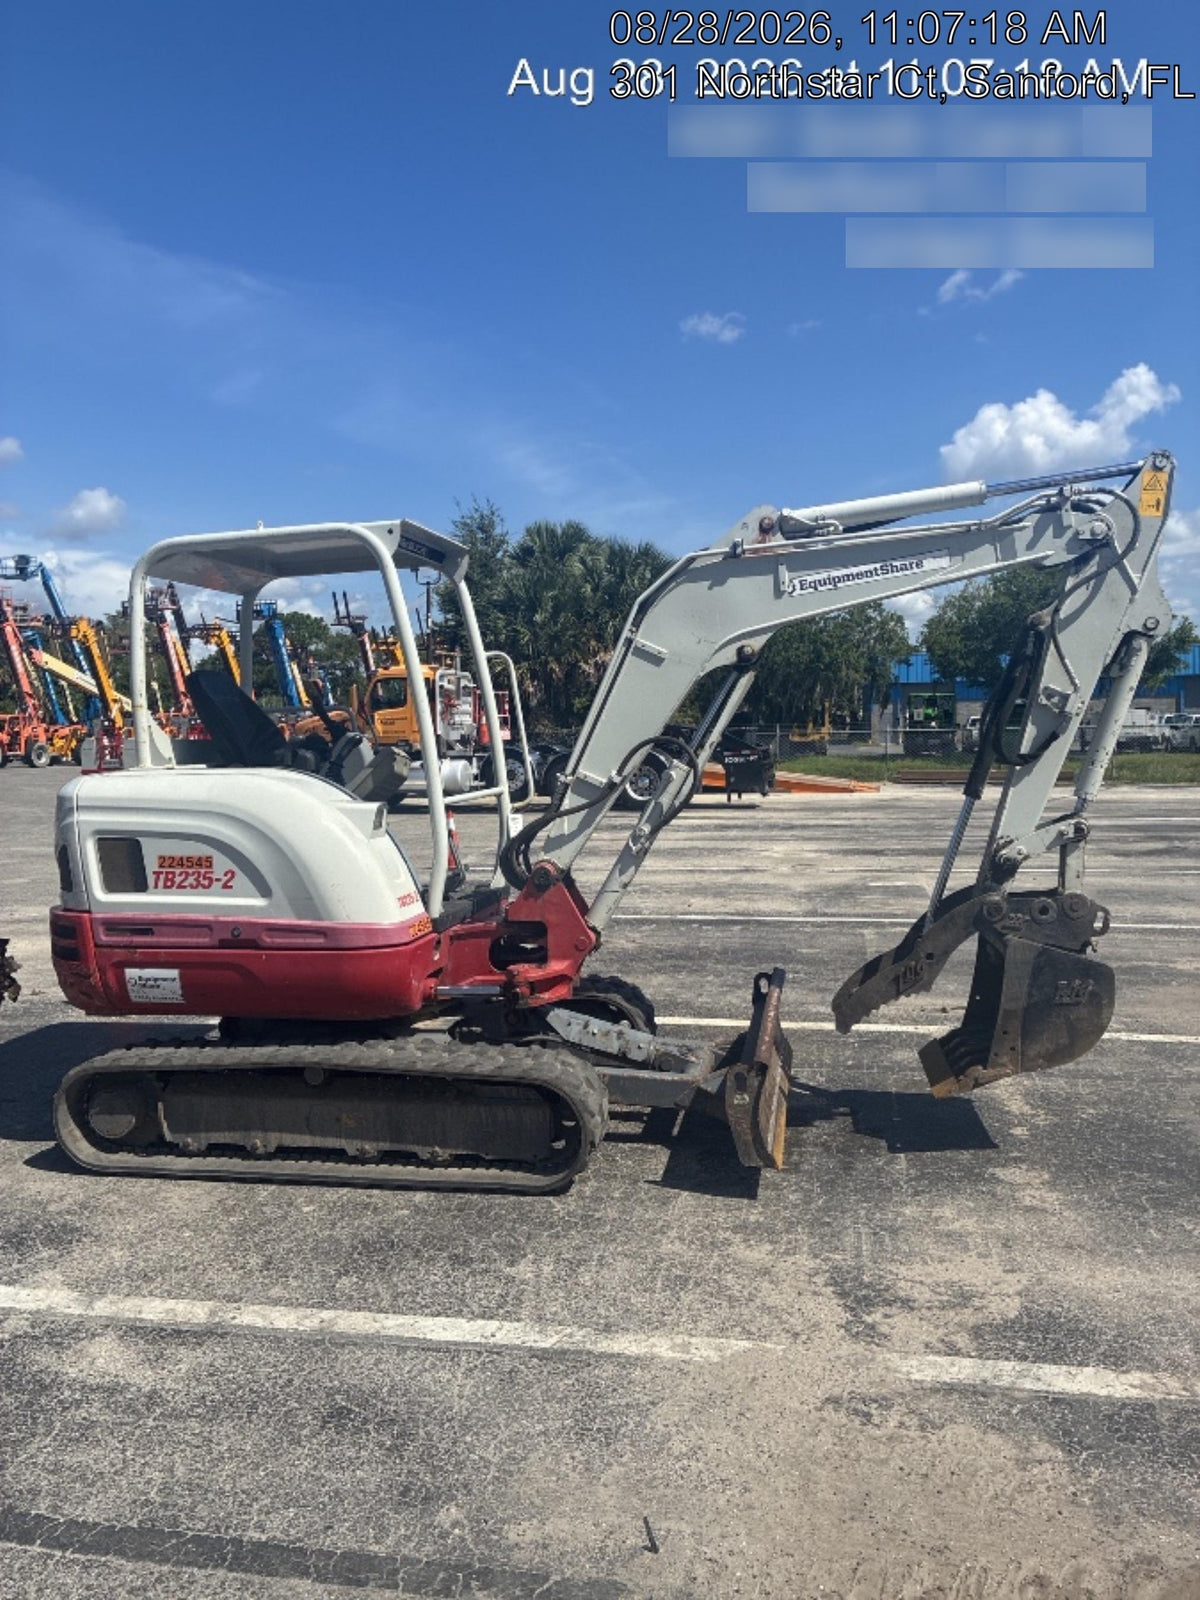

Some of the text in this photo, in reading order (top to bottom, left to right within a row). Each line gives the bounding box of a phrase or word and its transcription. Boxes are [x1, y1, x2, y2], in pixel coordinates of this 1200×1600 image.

[799, 559, 924, 592] EquipmentShare
[158, 856, 213, 869] 224545
[152, 869, 236, 889] TB235-2
